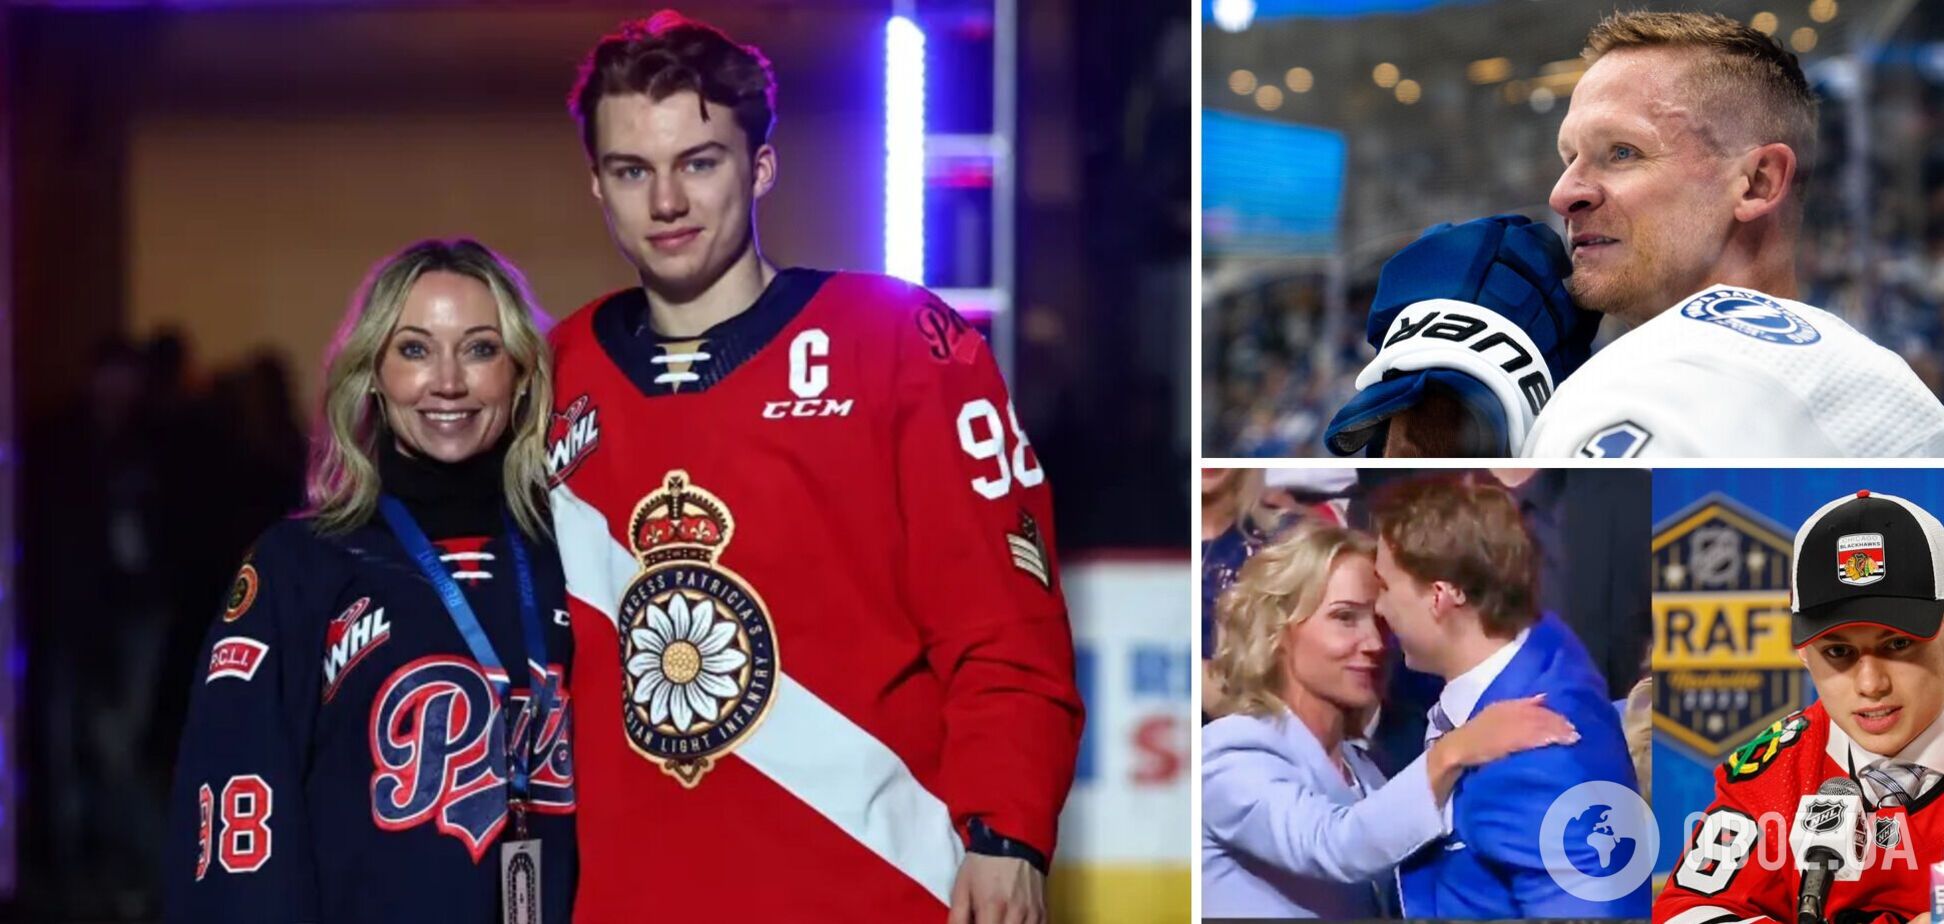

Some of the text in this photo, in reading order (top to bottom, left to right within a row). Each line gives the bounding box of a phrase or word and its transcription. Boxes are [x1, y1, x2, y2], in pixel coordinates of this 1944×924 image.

[789, 328, 829, 399] C
[546, 409, 599, 477] WHL
[762, 399, 855, 419] CCM
[956, 398, 1045, 500] 98
[1840, 541, 1881, 549] BLACKHAWKS
[619, 570, 764, 647] RINCESS PATRICIA'S
[1652, 607, 1792, 653] RAF
[323, 606, 391, 685] WHL
[660, 734, 711, 753] LIGHT
[718, 655, 769, 740] INFANTRY
[1673, 805, 1761, 897] 8
[1809, 808, 1838, 828] NHL
